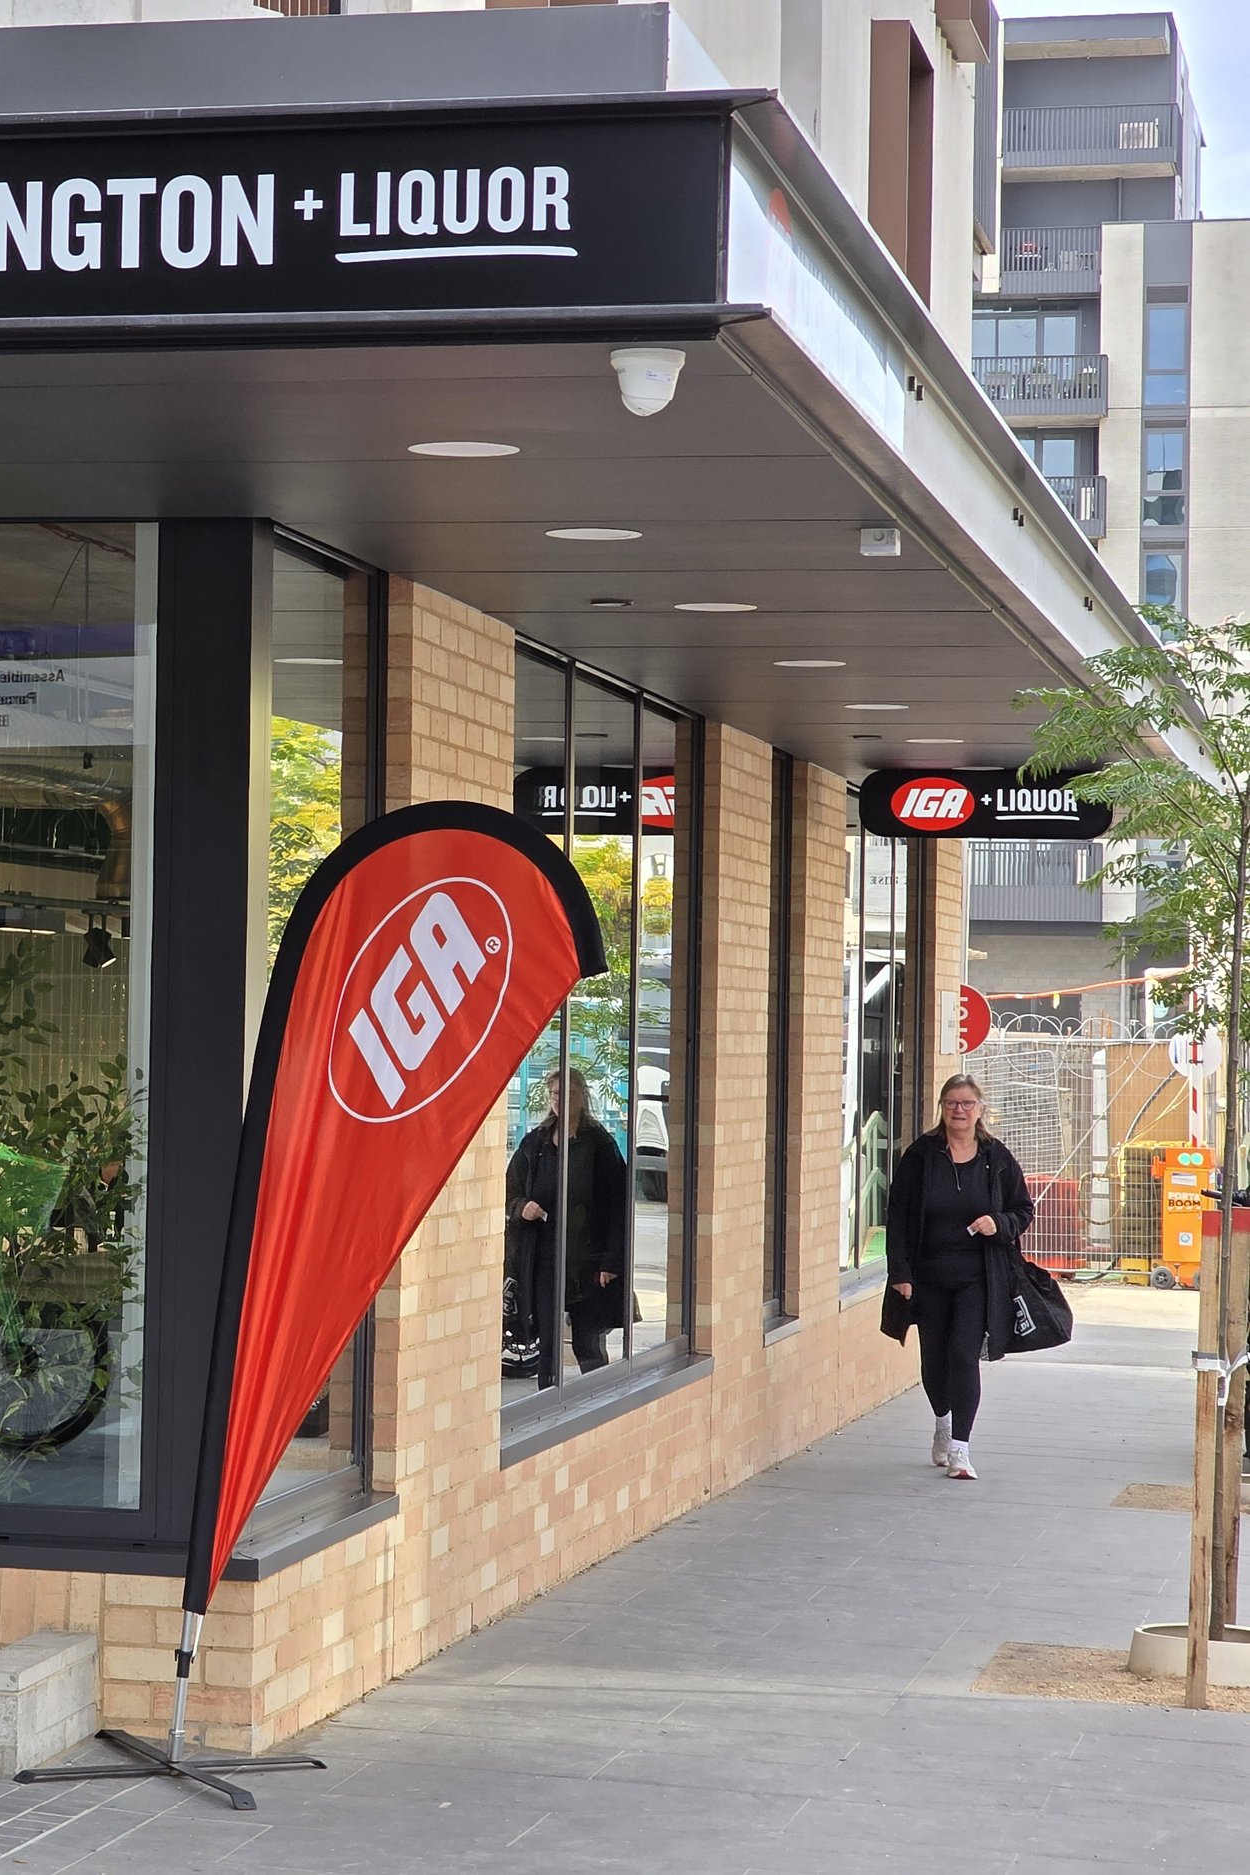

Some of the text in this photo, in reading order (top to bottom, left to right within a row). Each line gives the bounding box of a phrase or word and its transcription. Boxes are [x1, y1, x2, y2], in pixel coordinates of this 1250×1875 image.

[339, 166, 571, 237] LIQUOR
[996, 788, 1078, 812] LIQUOR
[348, 892, 487, 1110] IGA
[1168, 1199, 1201, 1207] BOOM
